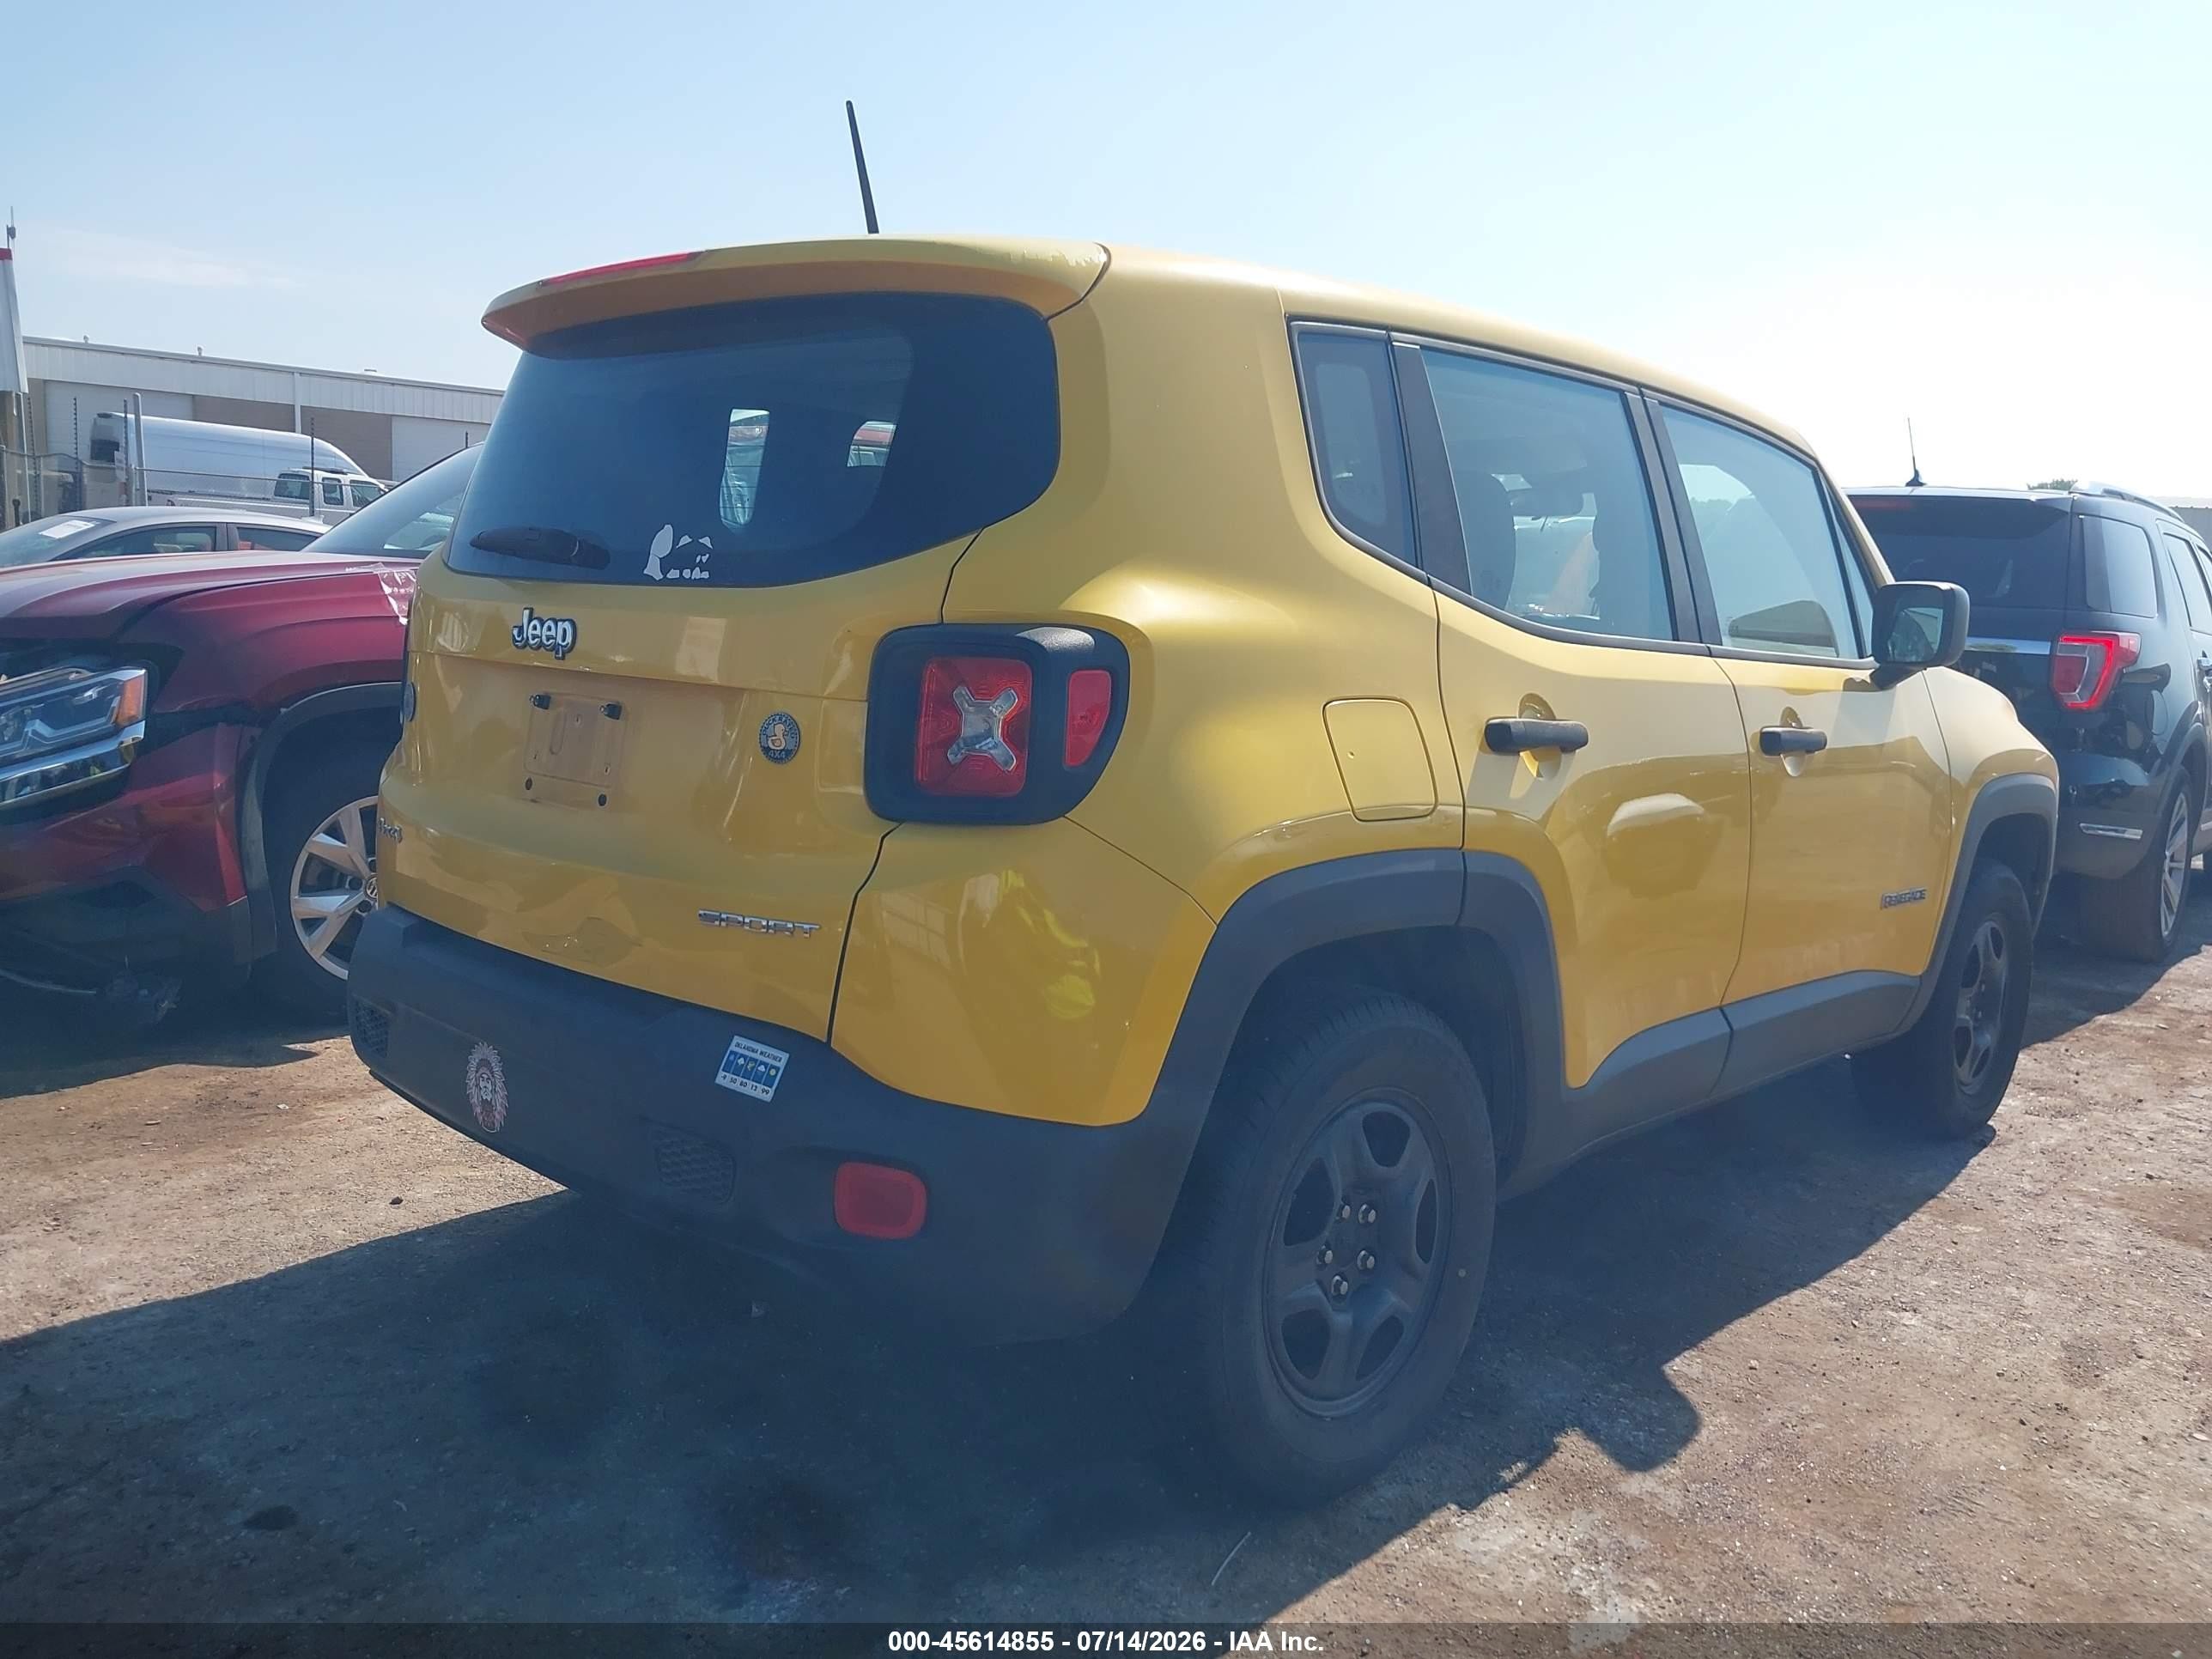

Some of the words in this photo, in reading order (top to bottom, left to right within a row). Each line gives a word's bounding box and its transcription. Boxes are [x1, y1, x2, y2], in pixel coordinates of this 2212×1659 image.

[512, 607, 576, 660] Jeep
[762, 714, 777, 735] DUCK
[698, 909, 821, 939] SPORT
